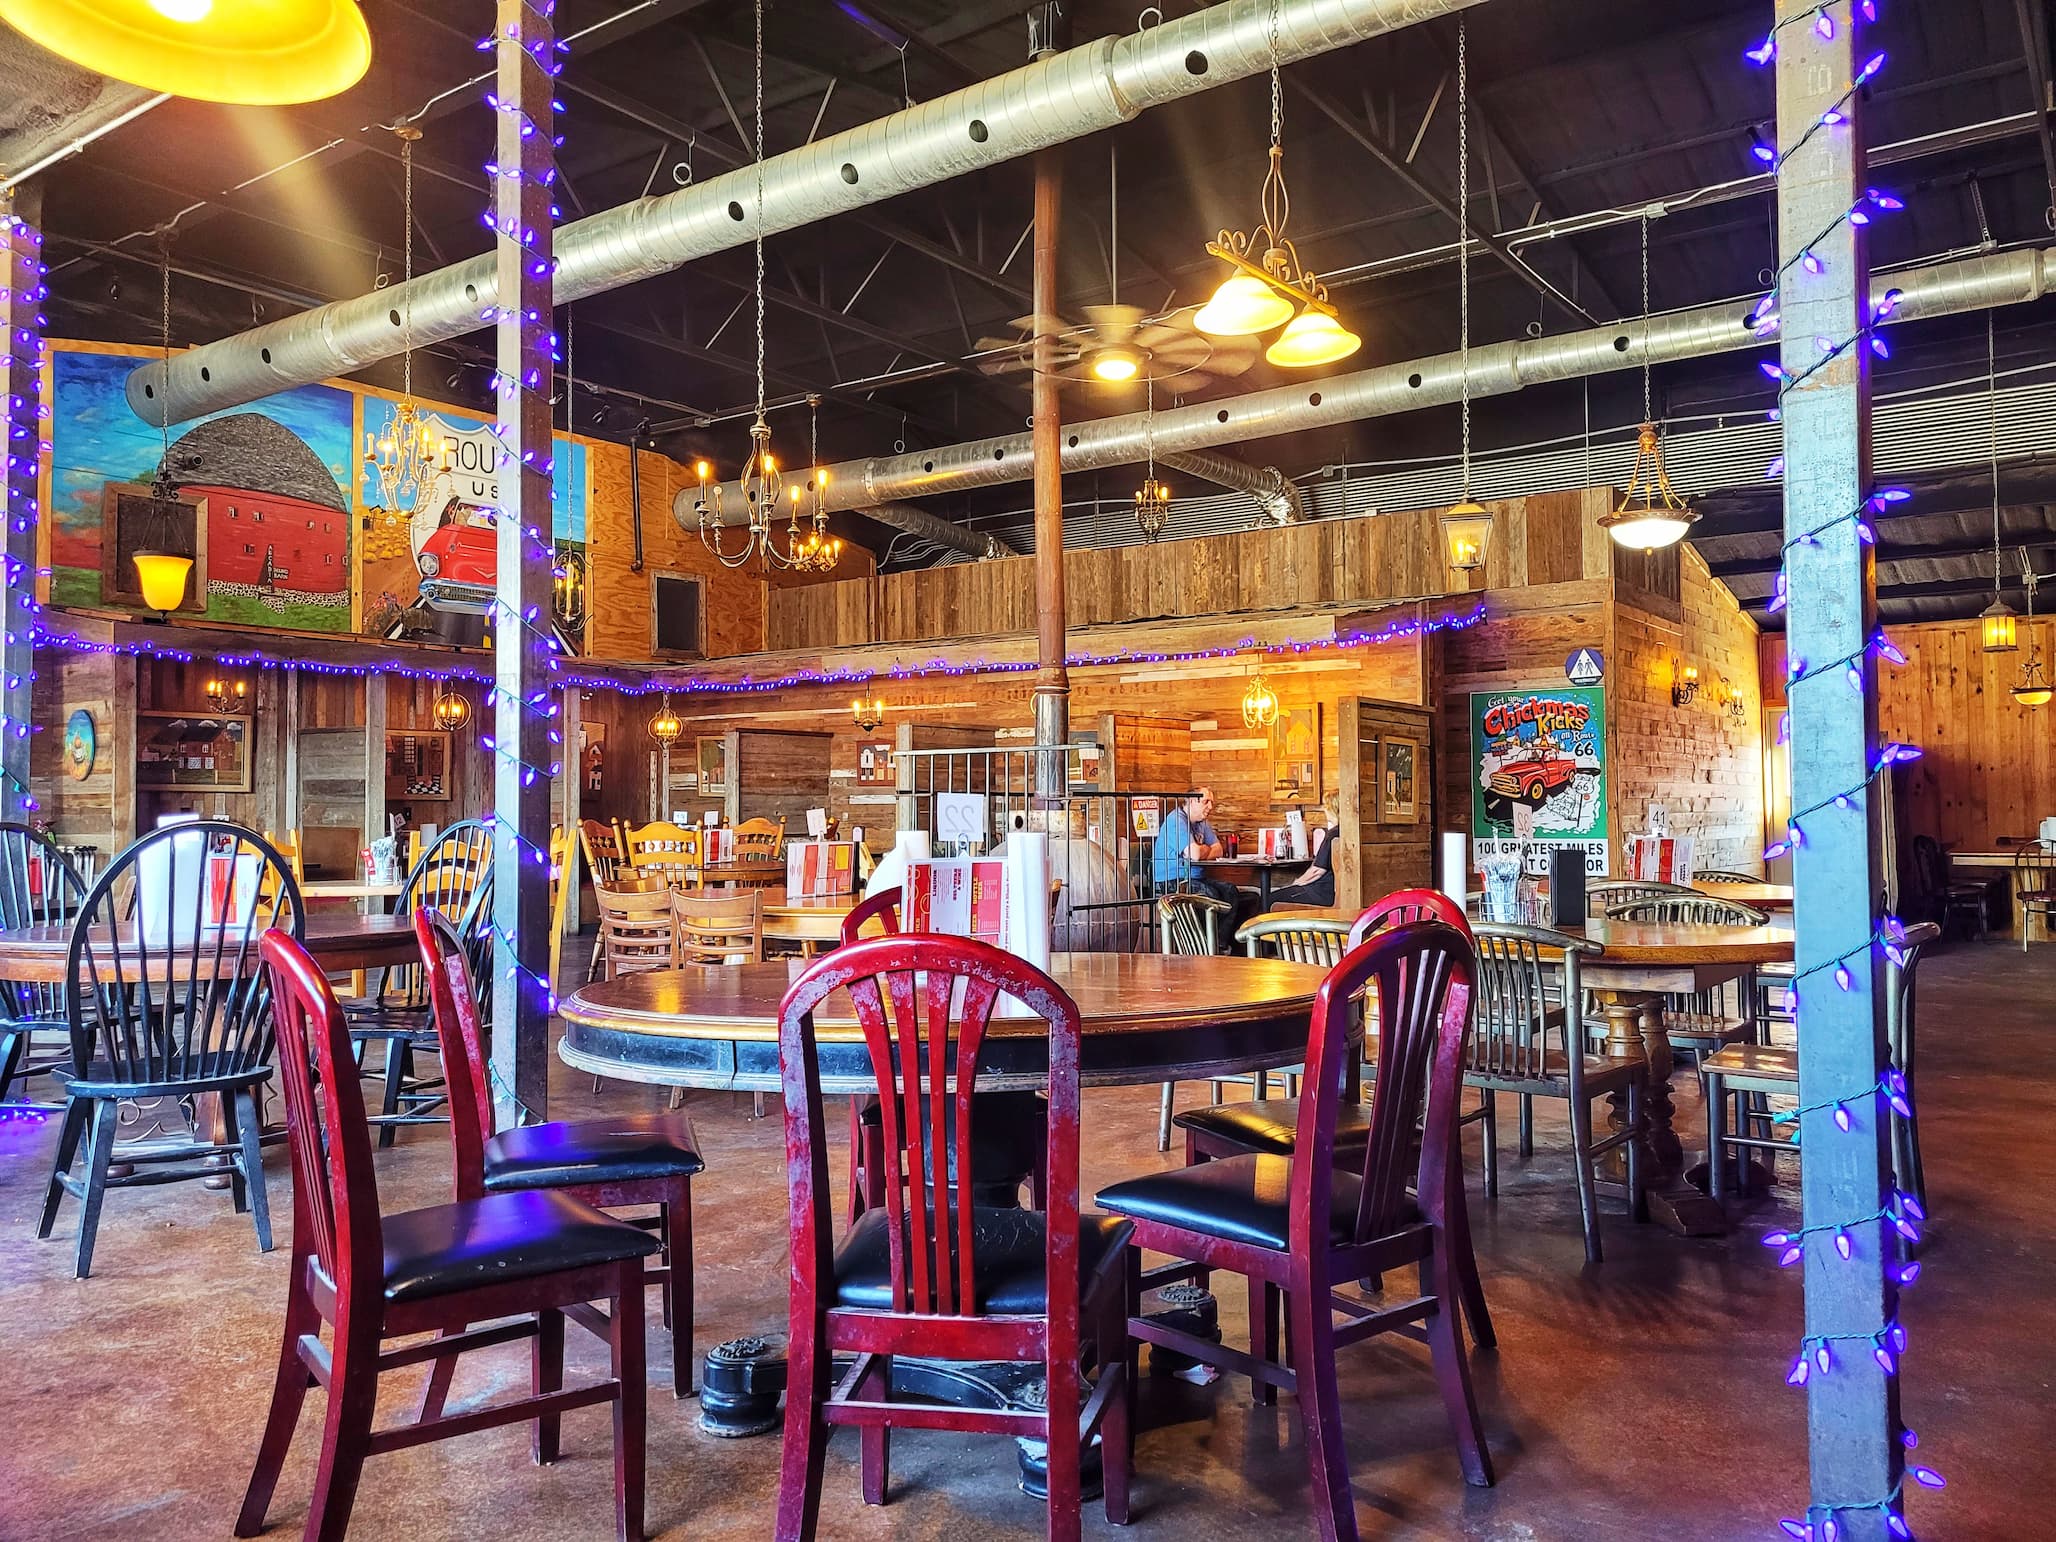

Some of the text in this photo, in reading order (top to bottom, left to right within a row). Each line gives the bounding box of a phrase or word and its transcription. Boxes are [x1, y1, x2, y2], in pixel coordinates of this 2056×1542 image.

[444, 435, 498, 474] ROU
[1484, 697, 1590, 737] Chickmas
[1536, 711, 1585, 736] Kicks
[1572, 730, 1594, 741] Route
[1574, 741, 1594, 756] 66
[1138, 800, 1157, 809] DANGER
[1652, 811, 1665, 824] 41
[1501, 842, 1561, 855] GRATEST
